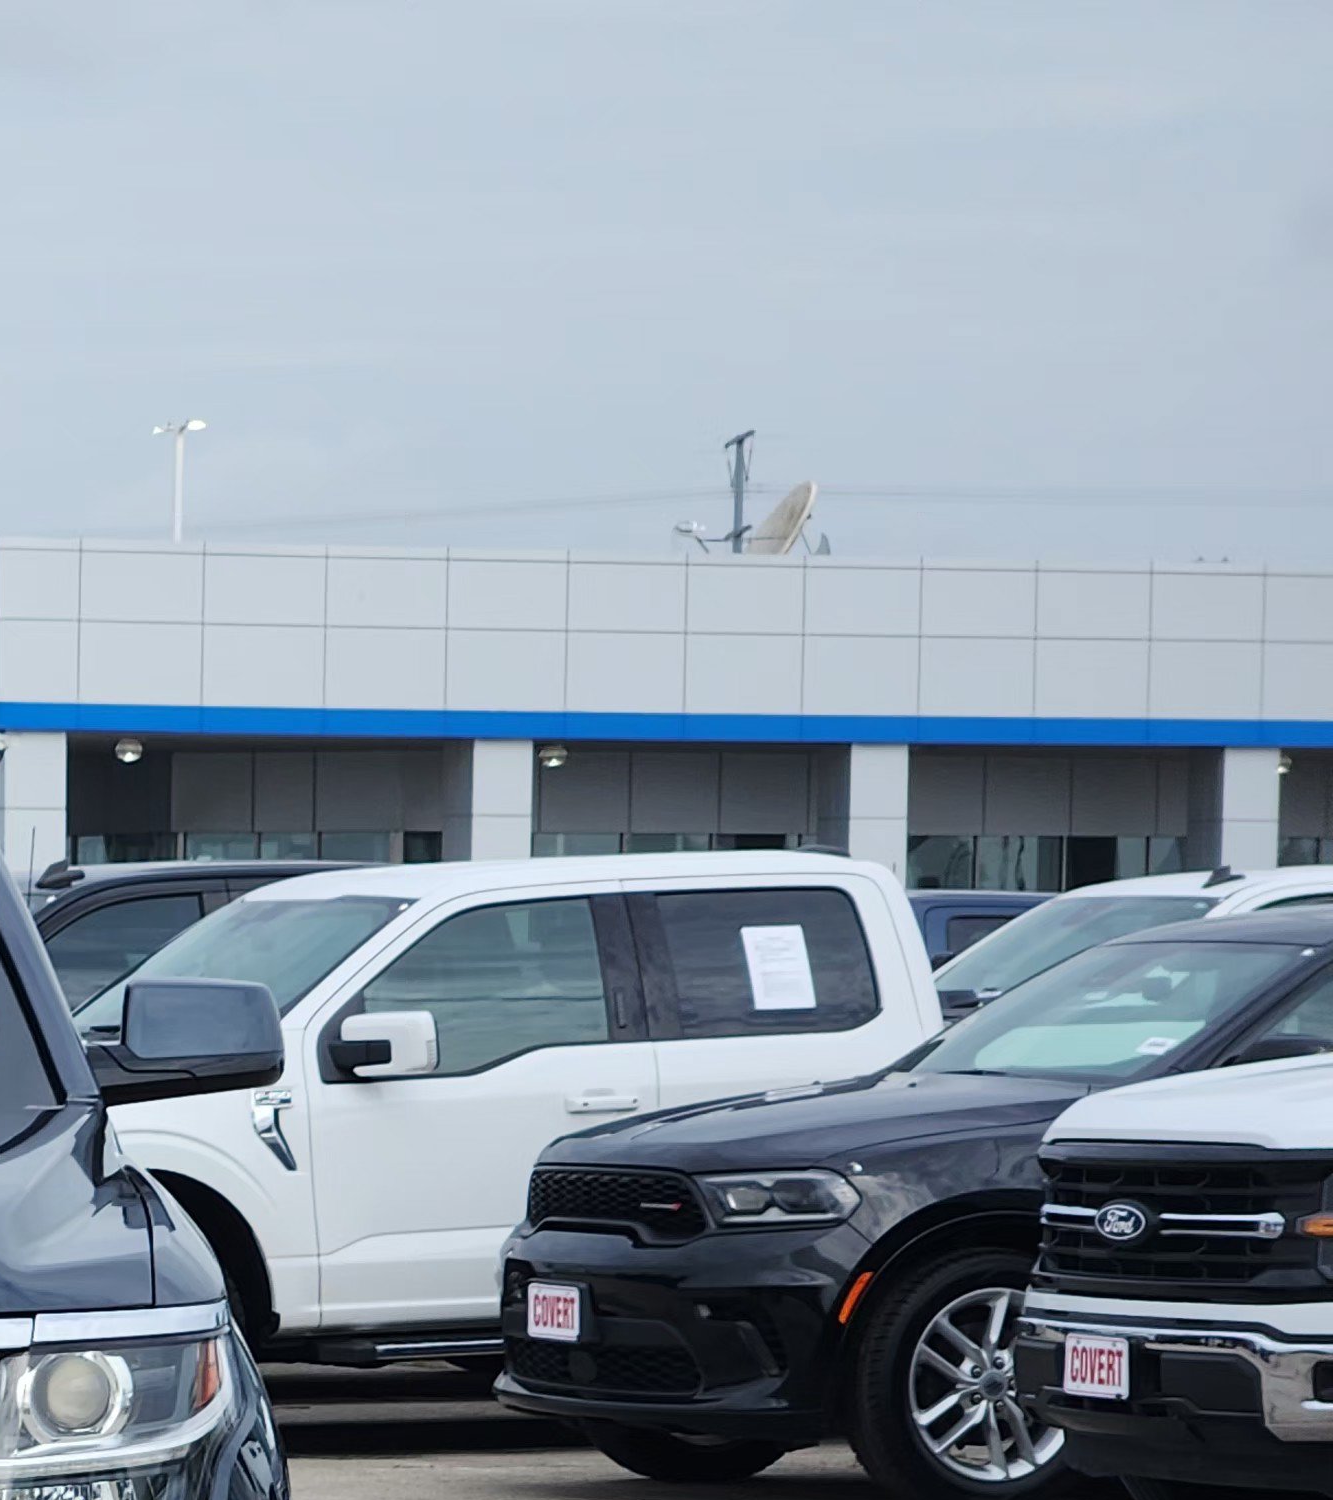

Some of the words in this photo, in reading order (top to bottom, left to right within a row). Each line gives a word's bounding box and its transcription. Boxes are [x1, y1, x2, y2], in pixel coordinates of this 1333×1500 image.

[1103, 1209, 1136, 1234] Ford
[533, 1294, 575, 1330] COVERT
[1070, 1345, 1123, 1388] COVERT
